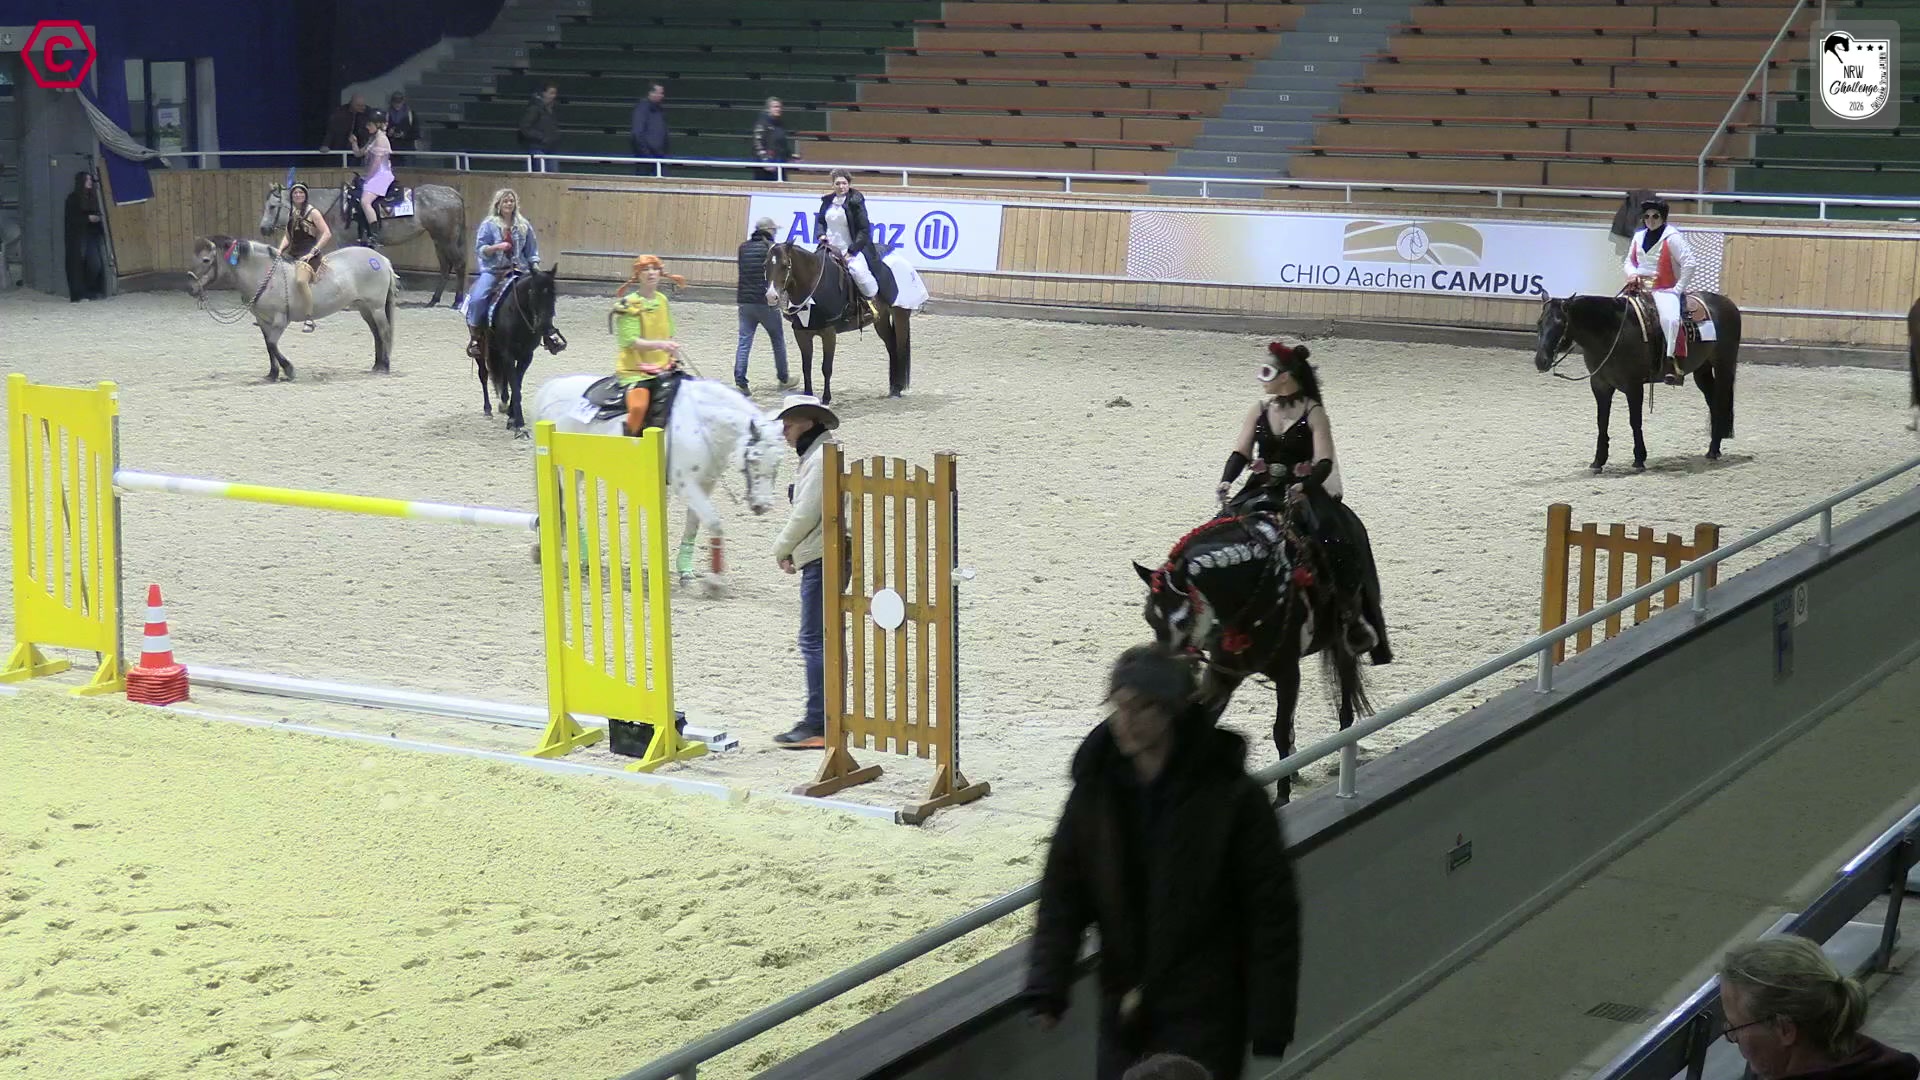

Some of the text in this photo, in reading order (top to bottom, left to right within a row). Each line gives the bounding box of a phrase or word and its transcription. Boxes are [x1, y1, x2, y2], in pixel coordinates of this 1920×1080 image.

[786, 211, 906, 249] Alnz
[1280, 263, 1543, 295] CHIO Aachen CAMPUS
